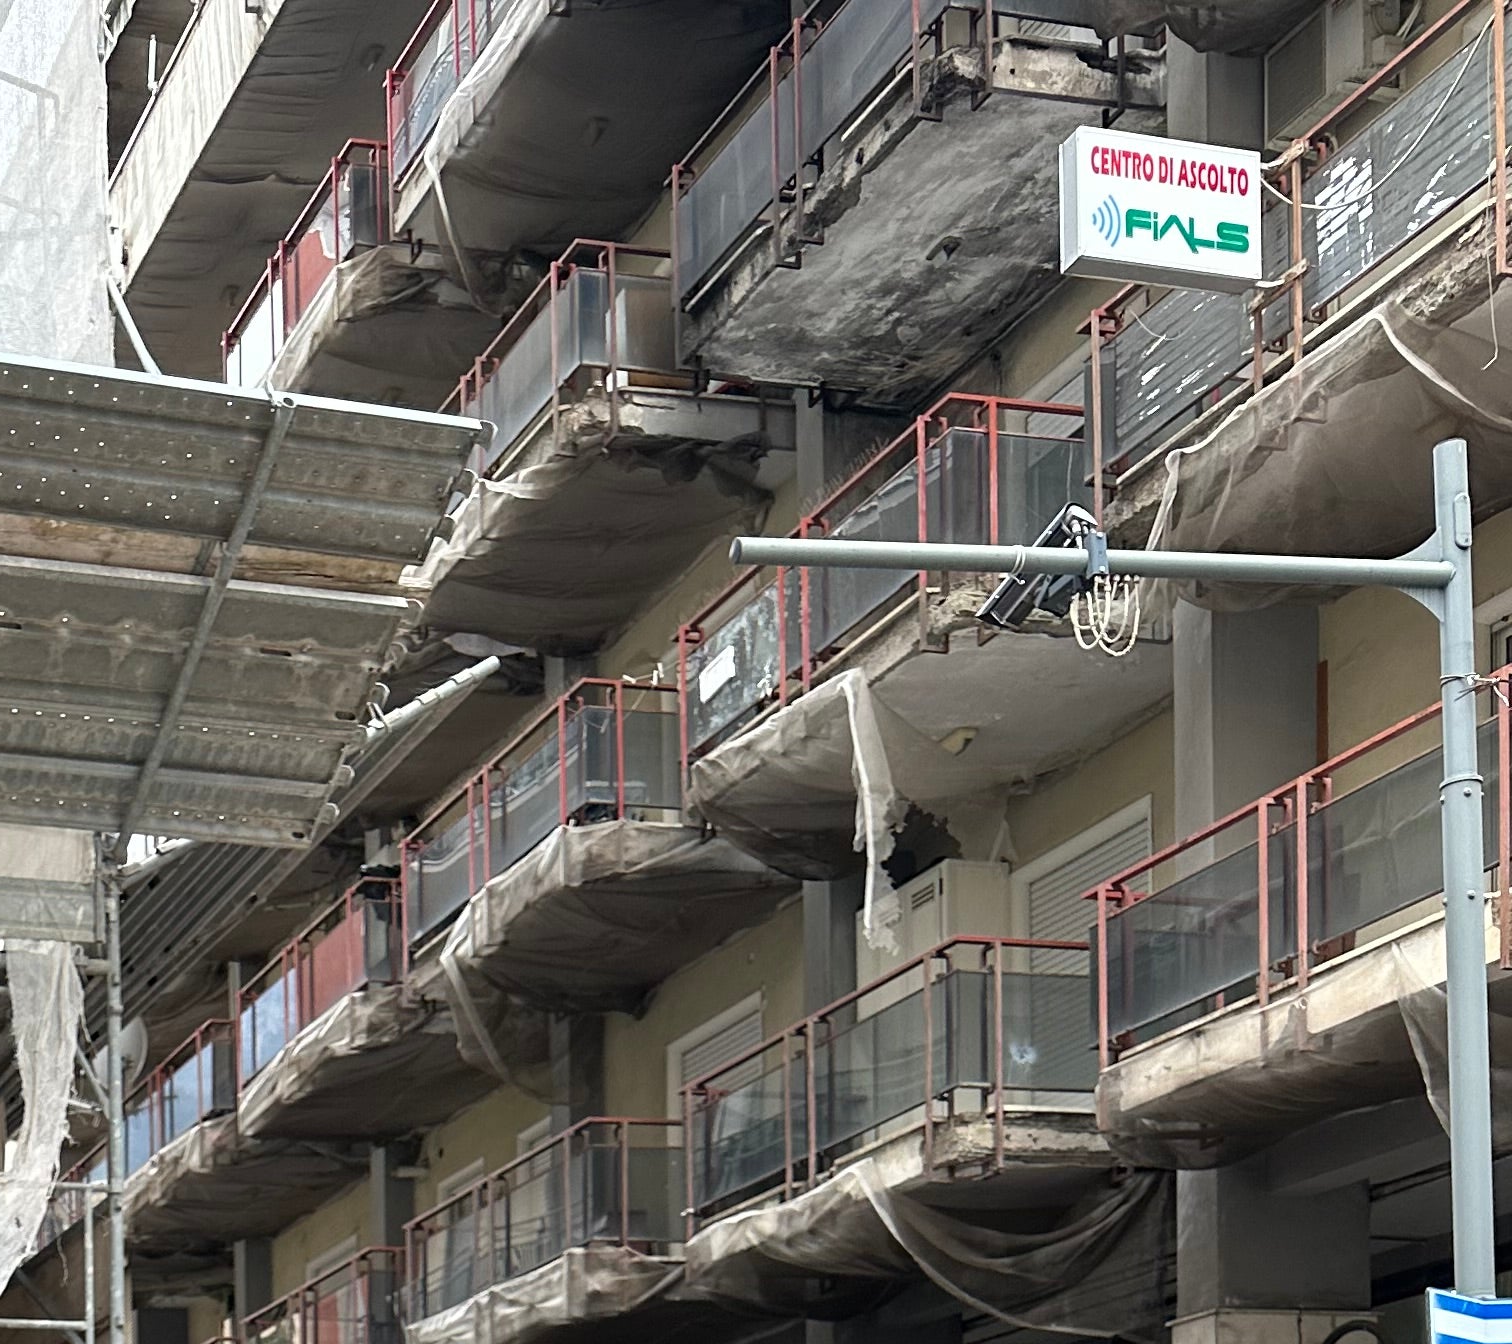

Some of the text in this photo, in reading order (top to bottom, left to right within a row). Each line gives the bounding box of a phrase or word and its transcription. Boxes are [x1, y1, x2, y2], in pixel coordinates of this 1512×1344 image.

[1090, 145, 1249, 197] CENTRO DI ASCOLTO
